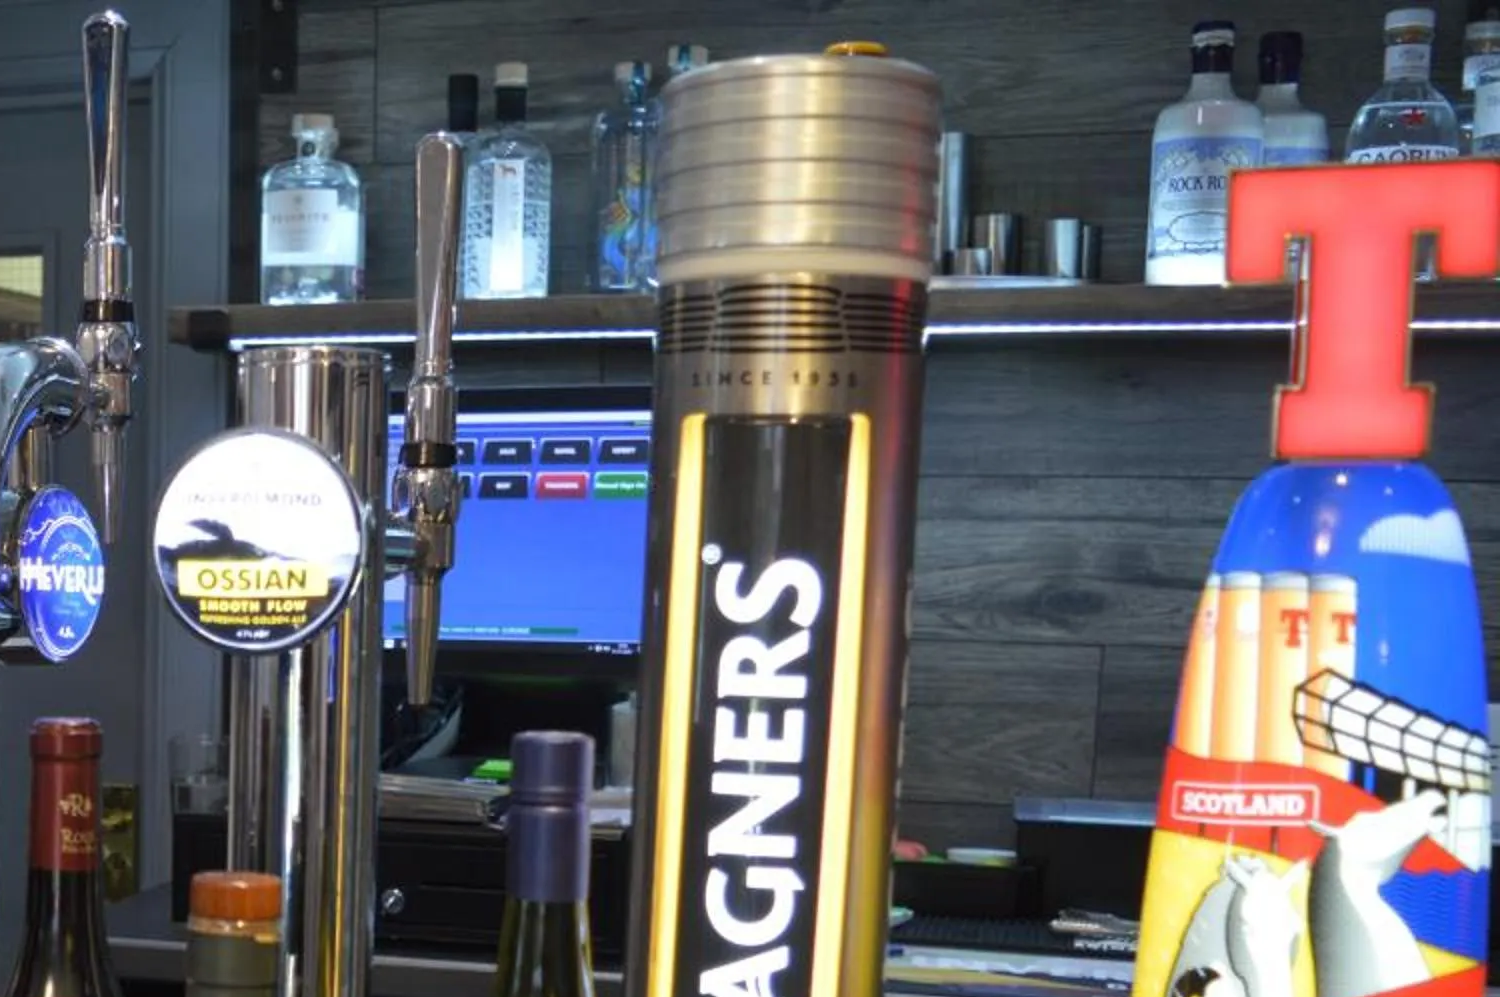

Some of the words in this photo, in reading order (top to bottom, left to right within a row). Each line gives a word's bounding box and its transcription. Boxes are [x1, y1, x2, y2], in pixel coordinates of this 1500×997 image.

[692, 371, 772, 388] SINCE
[197, 568, 308, 591] OSSIAN
[199, 599, 260, 613] SMOOTH
[267, 599, 308, 613] FLOW
[1182, 791, 1306, 817] SCOTLAND
